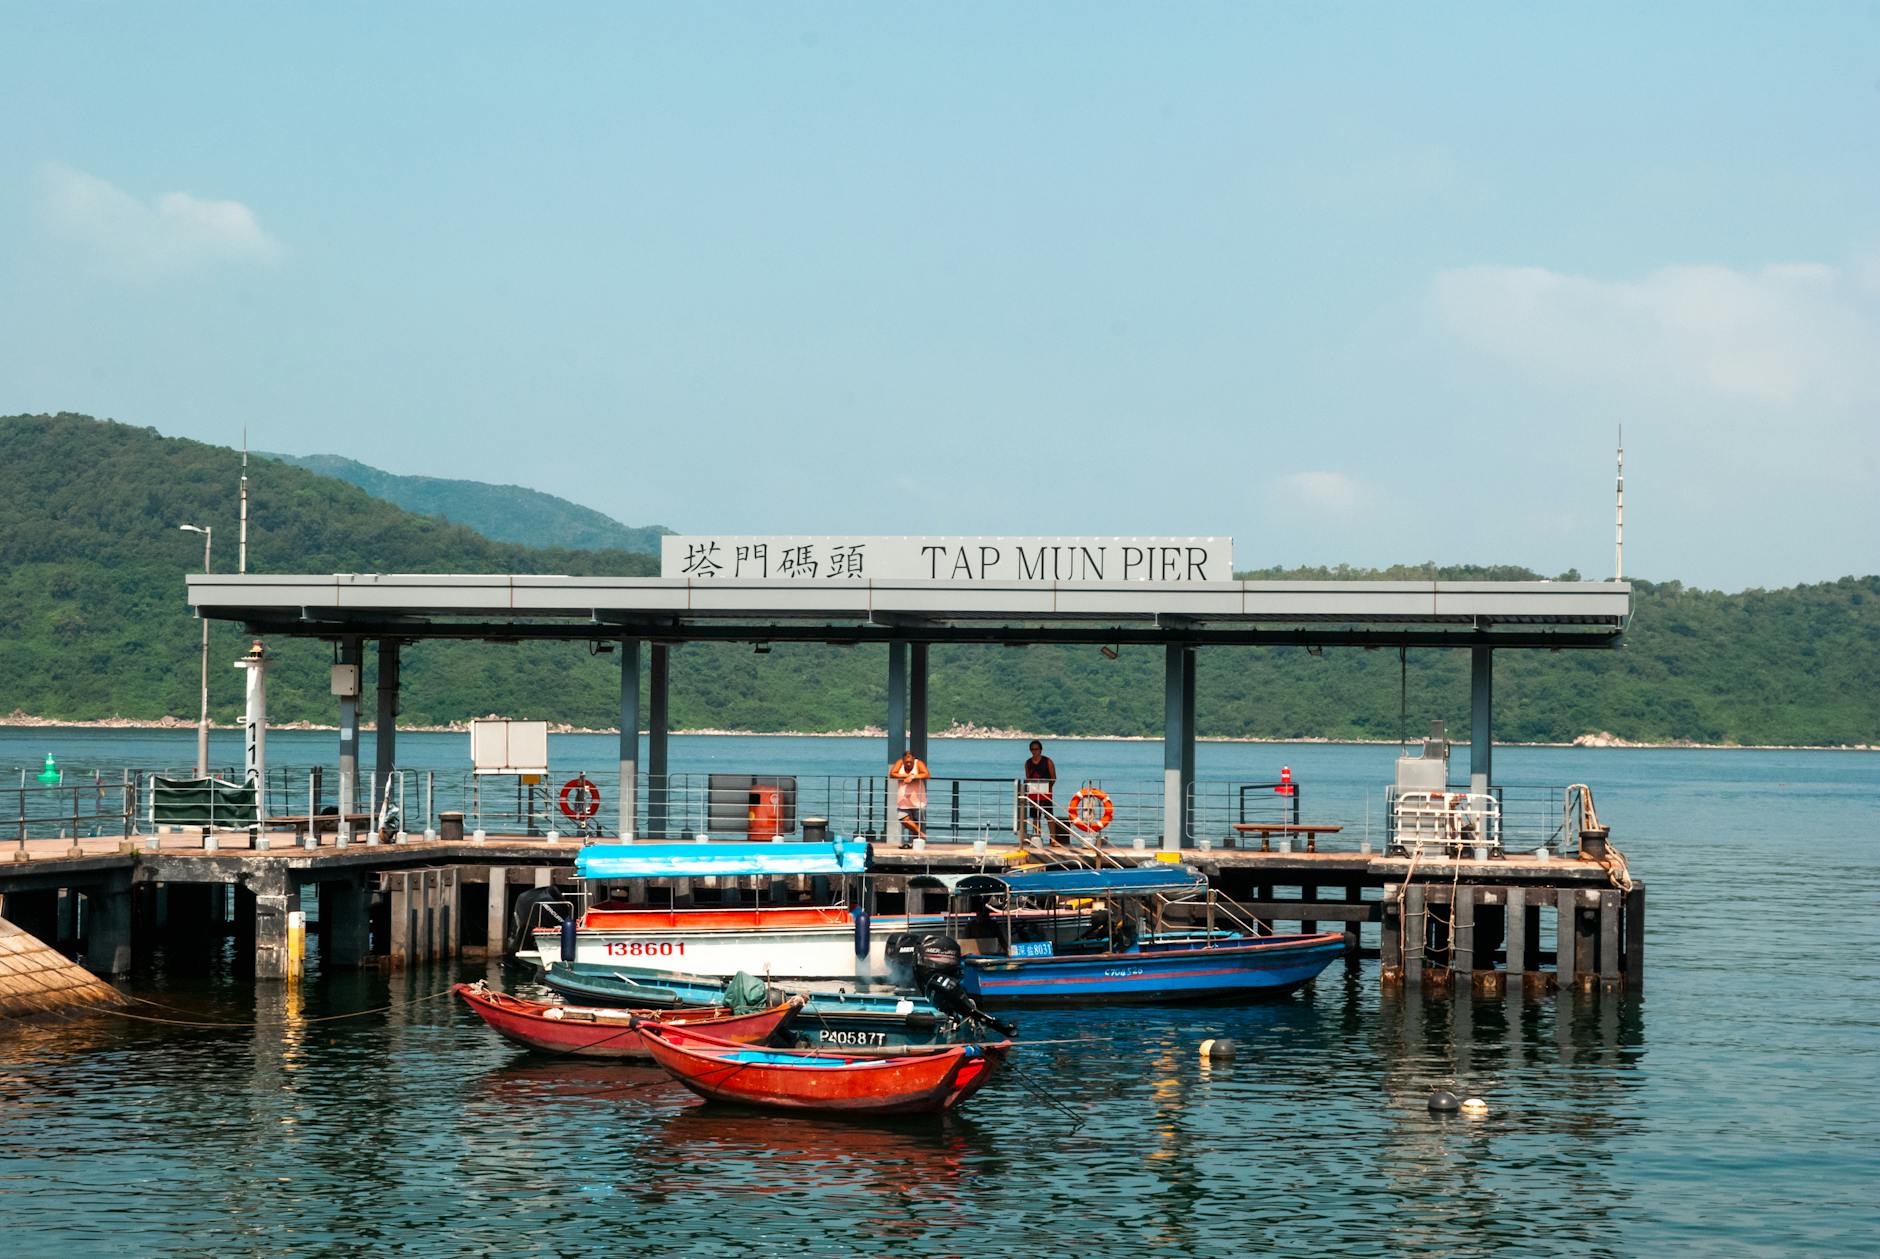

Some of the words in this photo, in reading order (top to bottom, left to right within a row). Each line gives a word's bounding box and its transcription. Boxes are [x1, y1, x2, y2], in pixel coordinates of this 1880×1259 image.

[681, 541, 866, 579] 塔門碼頭
[921, 545, 1000, 580] TAP
[1015, 546, 1106, 581] MUN
[1121, 547, 1208, 581] PIER
[602, 942, 684, 956] 138601
[819, 1029, 886, 1046] P40587T
